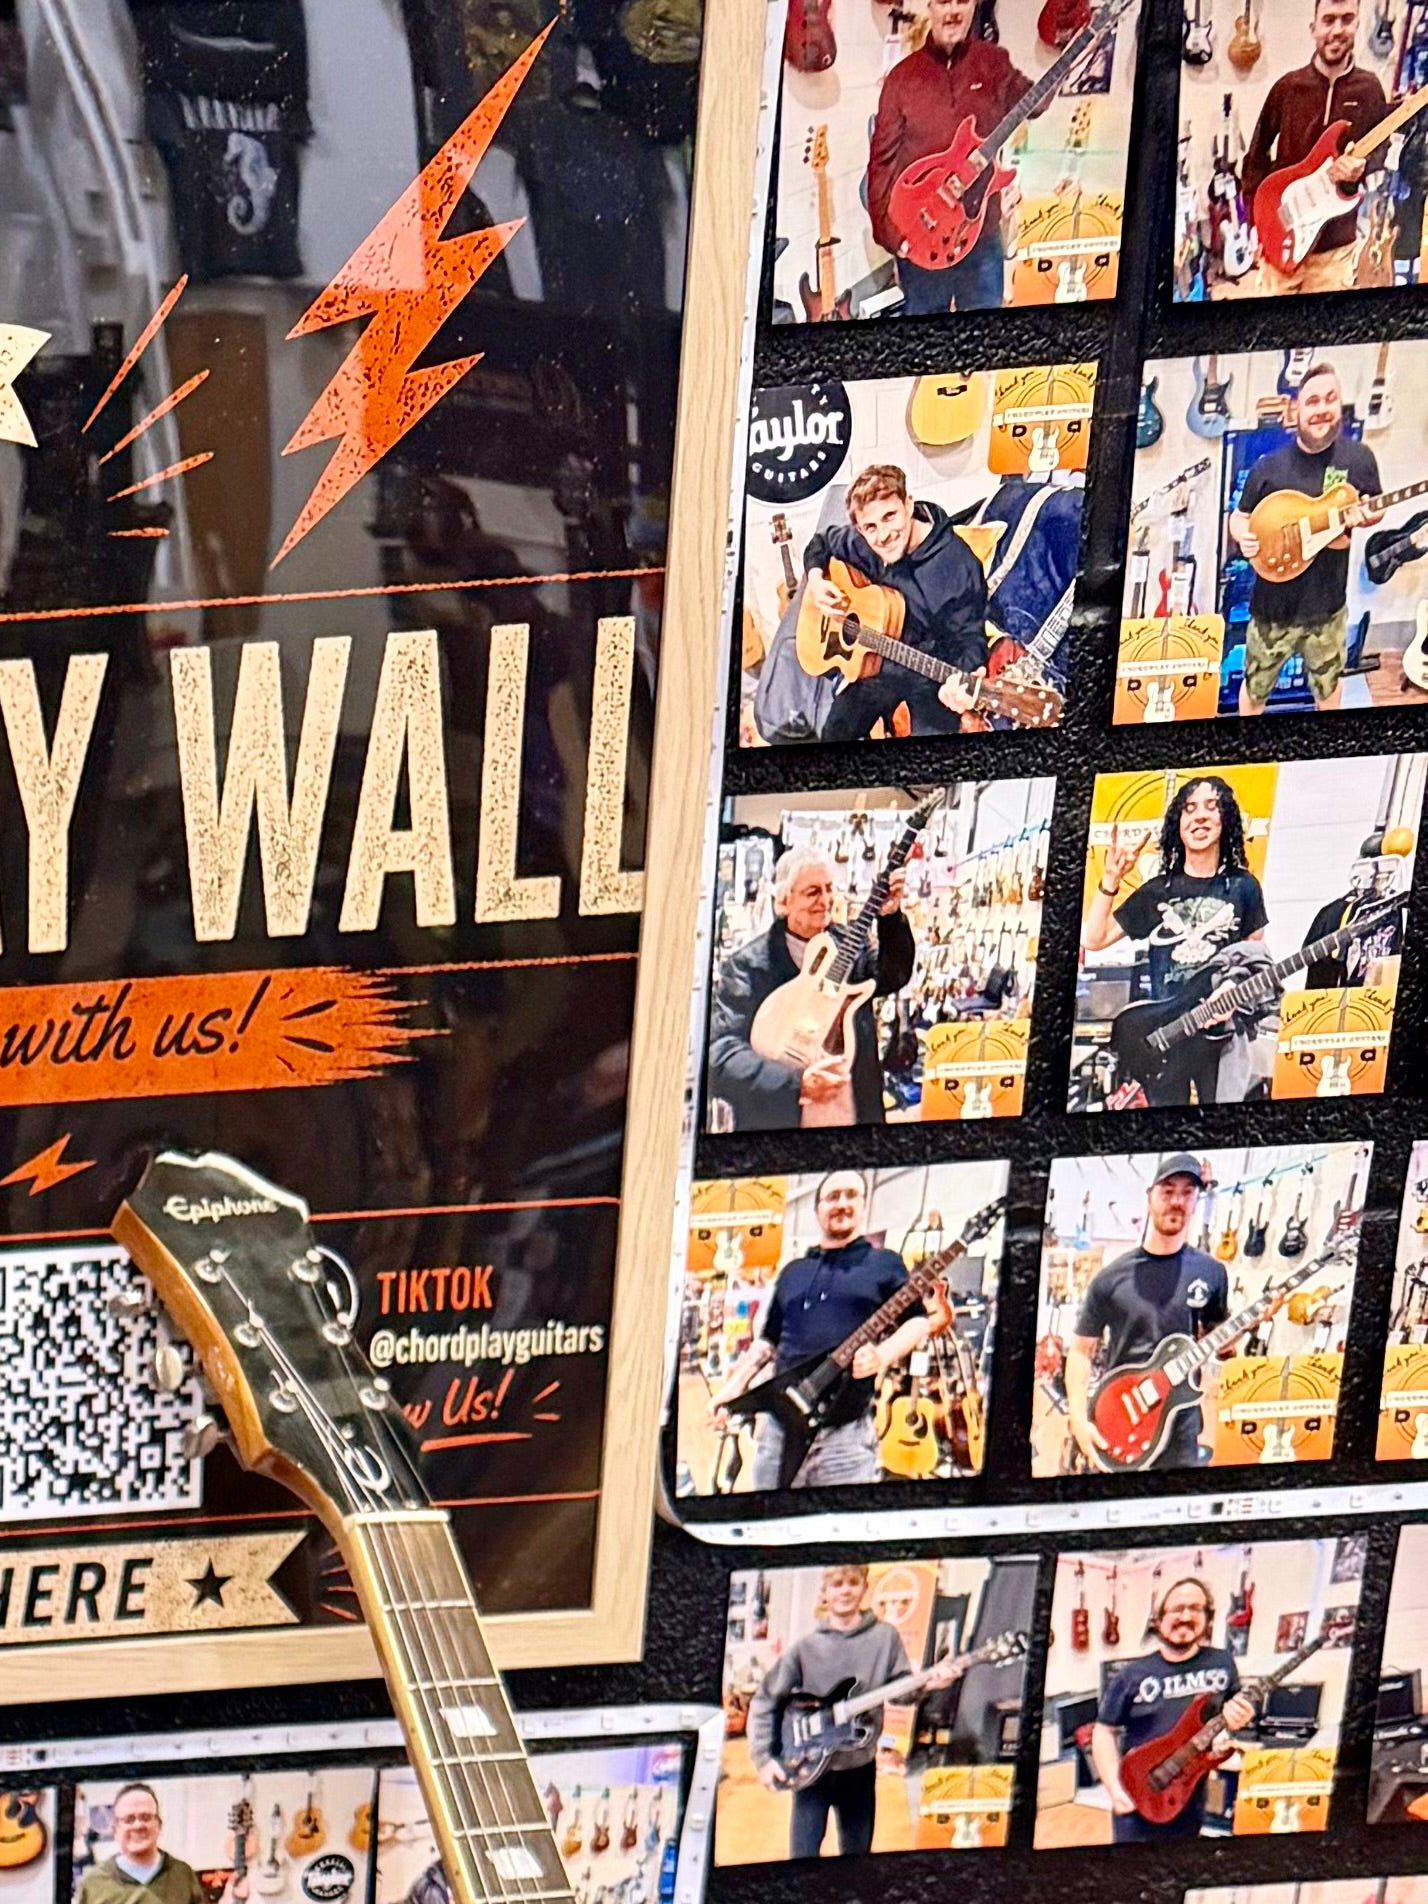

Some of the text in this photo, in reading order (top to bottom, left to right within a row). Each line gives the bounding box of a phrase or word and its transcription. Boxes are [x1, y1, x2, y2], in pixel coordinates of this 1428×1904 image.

[748, 400, 845, 461] aylor
[751, 450, 828, 484] GUITARS
[170, 615, 645, 943] WALL
[152, 975, 273, 1059] us!
[164, 1195, 278, 1224] Epiphone
[376, 1265, 494, 1316] TIKTOK
[369, 1320, 605, 1368] @chordplayguitars
[441, 1368, 510, 1423] Us!
